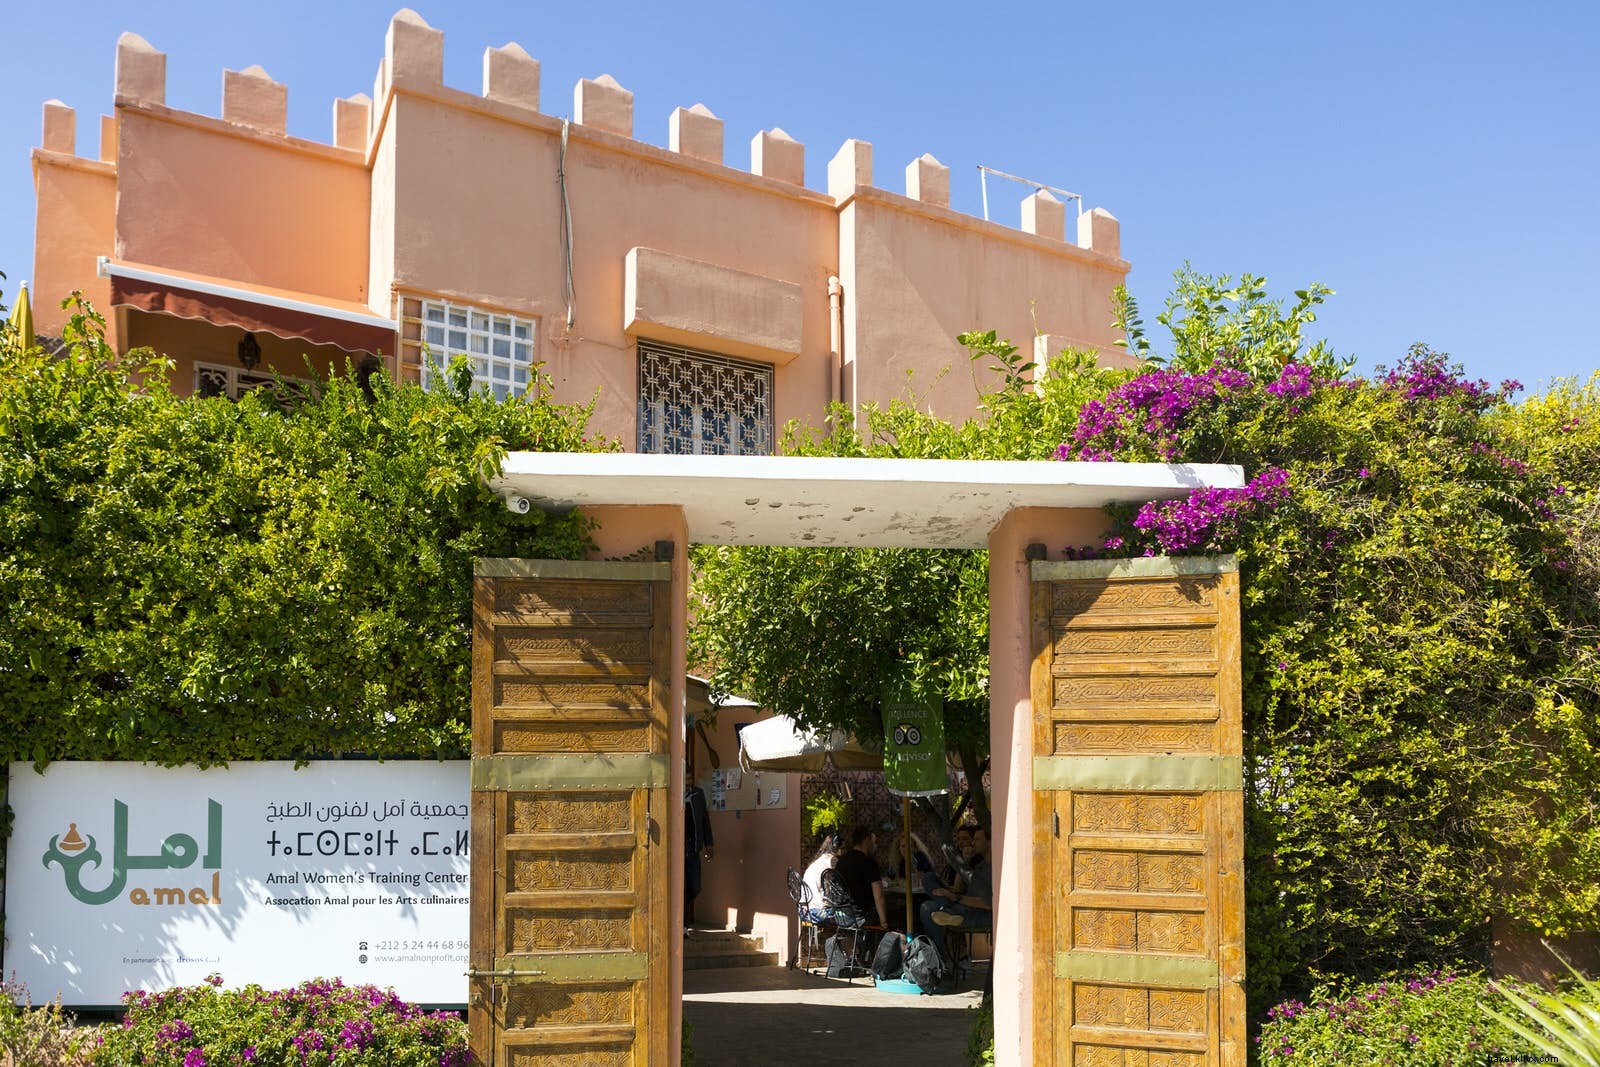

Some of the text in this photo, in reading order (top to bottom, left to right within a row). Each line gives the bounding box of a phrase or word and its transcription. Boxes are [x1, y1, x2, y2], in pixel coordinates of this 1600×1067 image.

[266, 801, 312, 823] الطبخ
[316, 801, 369, 823] لفنون
[410, 801, 469, 820] جمعية
[129, 870, 222, 906] amal
[266, 871, 469, 887] Amal Women's Training Center
[265, 893, 470, 908] Assocation Amal pour les Arts culinaires
[375, 940, 469, 950] +212 5 24 44 68 96
